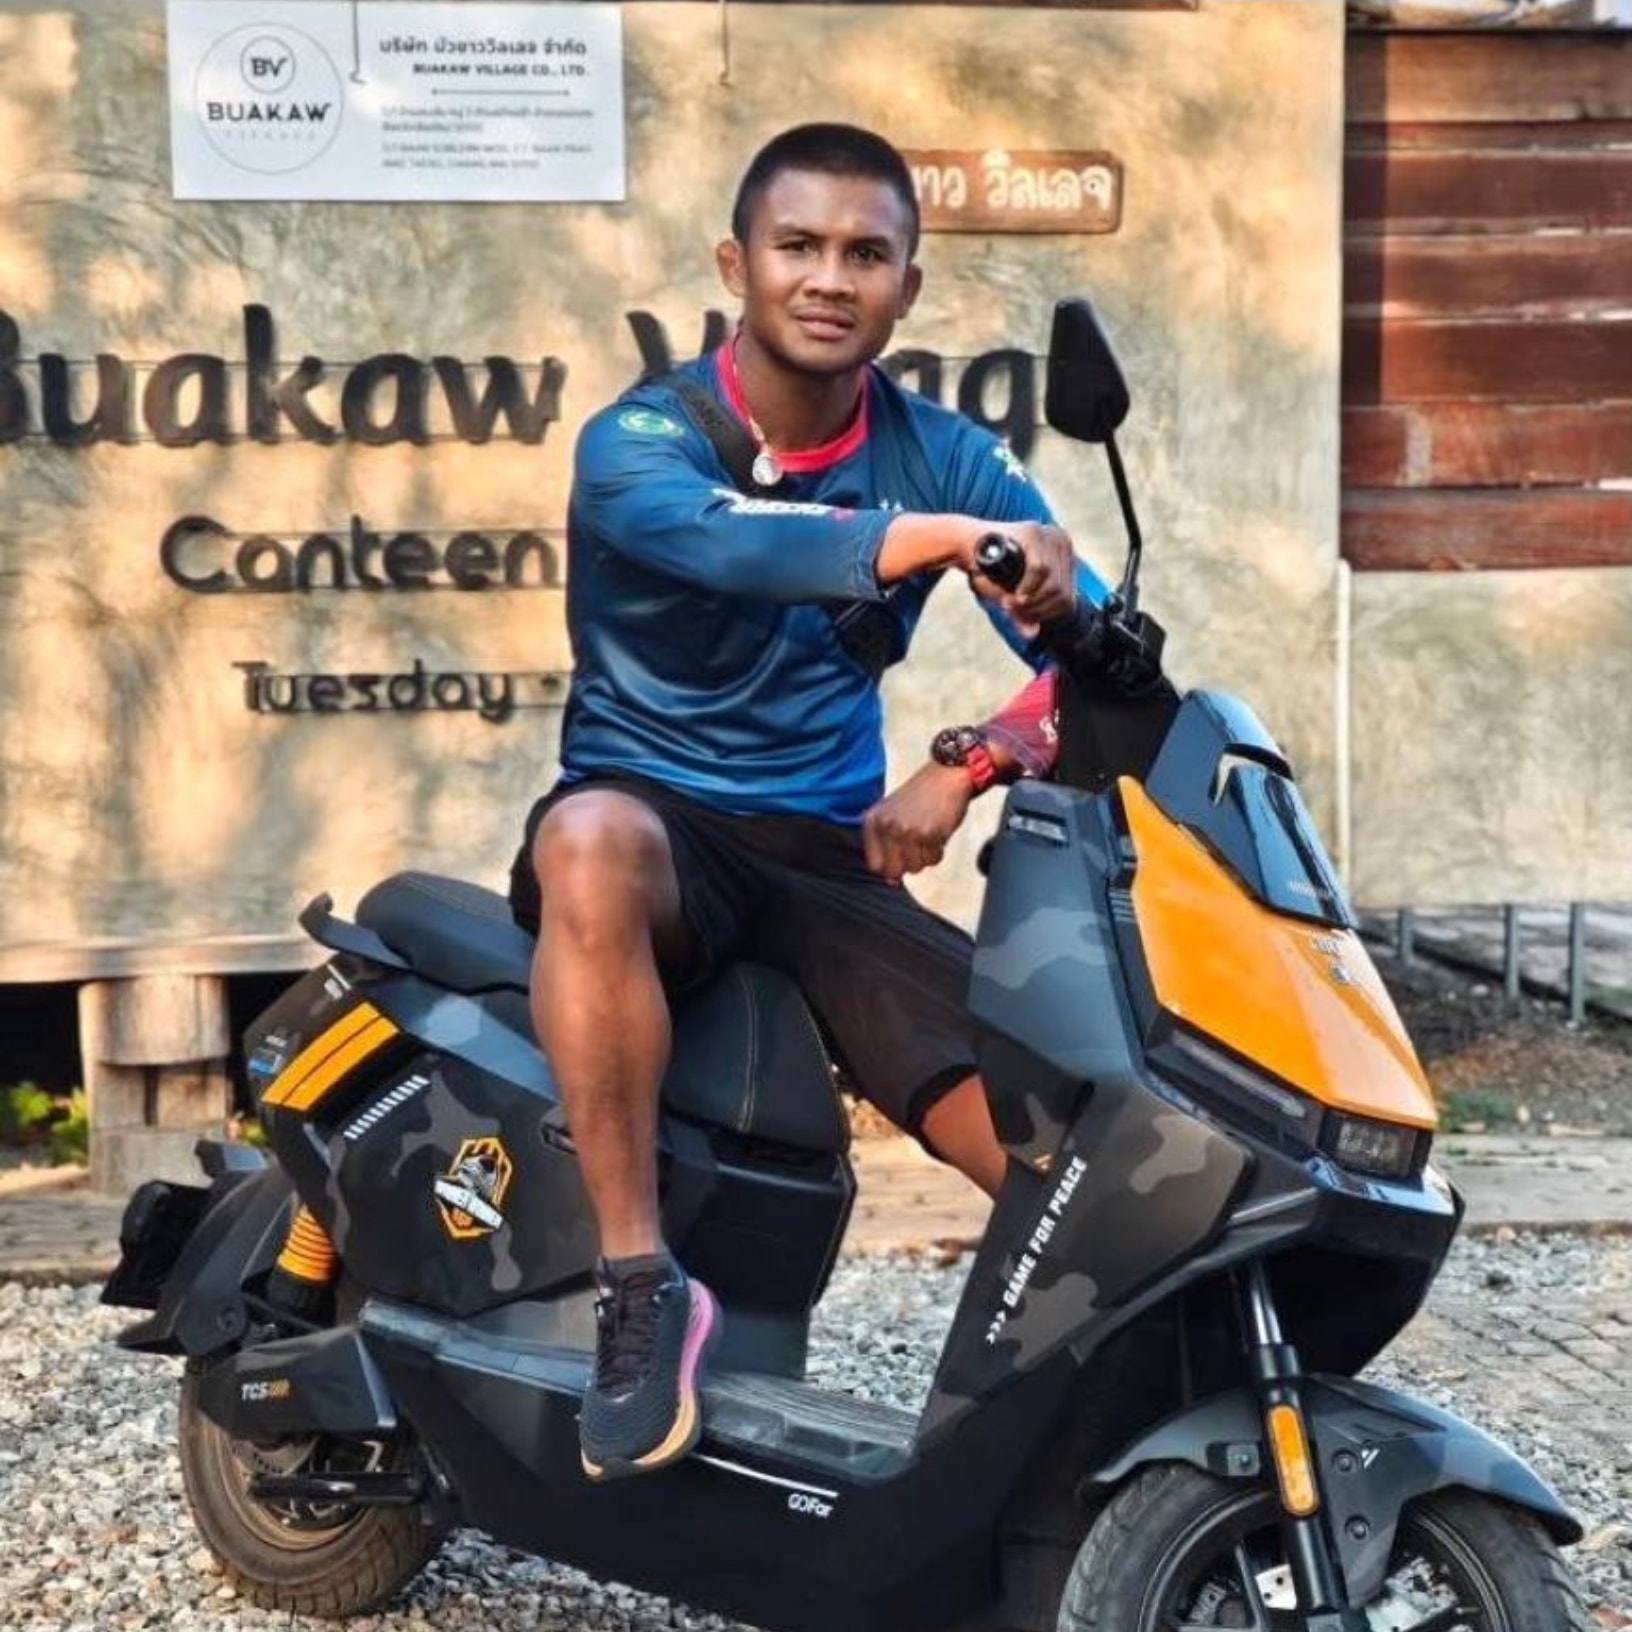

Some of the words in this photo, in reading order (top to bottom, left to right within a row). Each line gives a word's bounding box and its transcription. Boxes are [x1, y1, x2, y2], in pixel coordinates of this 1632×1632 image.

[251, 57, 288, 77] BV
[206, 101, 331, 122] BUAKAW
[160, 514, 560, 594] Canteen
[230, 658, 514, 726] Tuesday
[1003, 1253, 1037, 1308] GAME
[1028, 1215, 1056, 1254] FOR
[1048, 1155, 1088, 1217] PEACE
